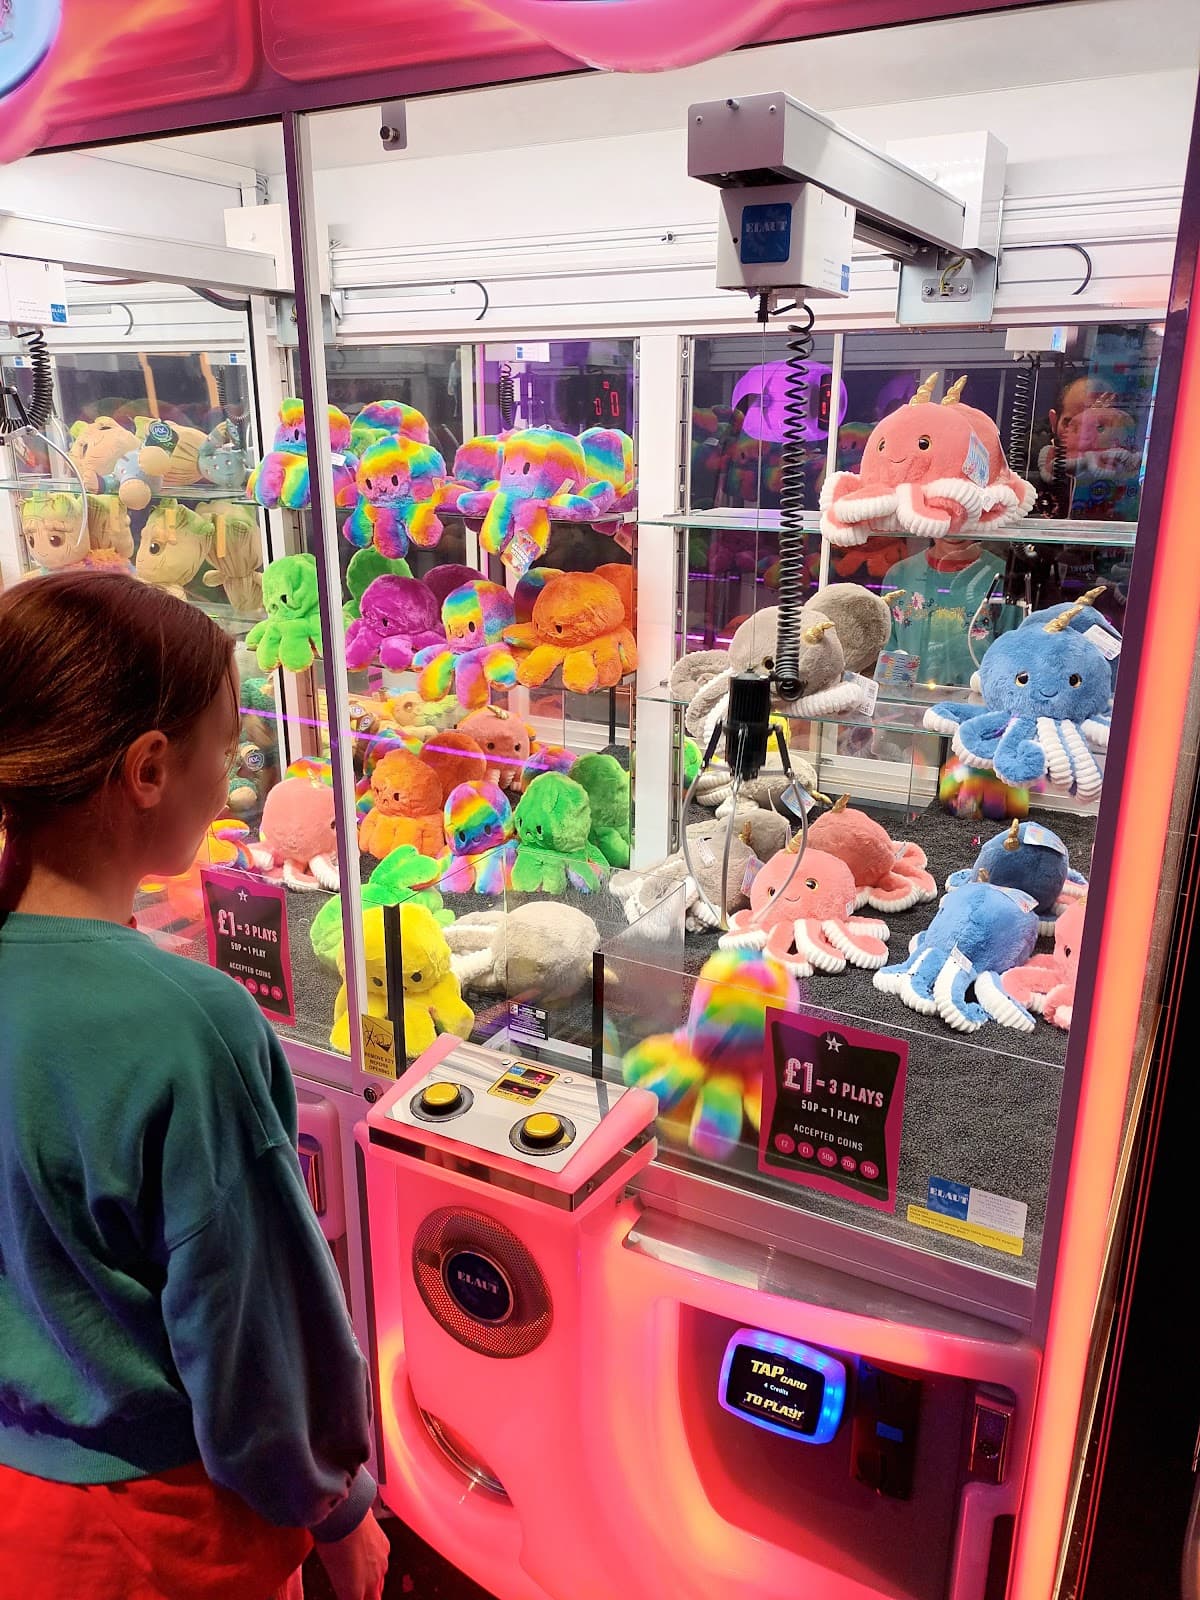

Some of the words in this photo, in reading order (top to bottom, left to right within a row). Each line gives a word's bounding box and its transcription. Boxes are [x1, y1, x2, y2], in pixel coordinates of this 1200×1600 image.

[745, 221, 788, 233] ELAUT
[218, 909, 236, 936] £1
[244, 923, 251, 936] 3
[252, 925, 277, 942] PLAYS
[252, 948, 266, 958] PLAY
[229, 962, 254, 974] ACCEPTED
[255, 968, 271, 979] COINS
[784, 1057, 814, 1094] £1
[829, 1079, 838, 1094] 3
[842, 1082, 884, 1108] PLAYS
[801, 1099, 819, 1113] 50P
[830, 1107, 834, 1118] 1
[837, 1109, 860, 1125] PLAY
[793, 1123, 834, 1143] ACCEPTED
[837, 1136, 863, 1152] COINS
[930, 1187, 968, 1204] ELAUT
[457, 1269, 500, 1295] ELAUT
[751, 1359, 785, 1378] TAP
[780, 1375, 808, 1391] CARD
[745, 1391, 763, 1406] TO
[763, 1399, 803, 1420] PLAY!
